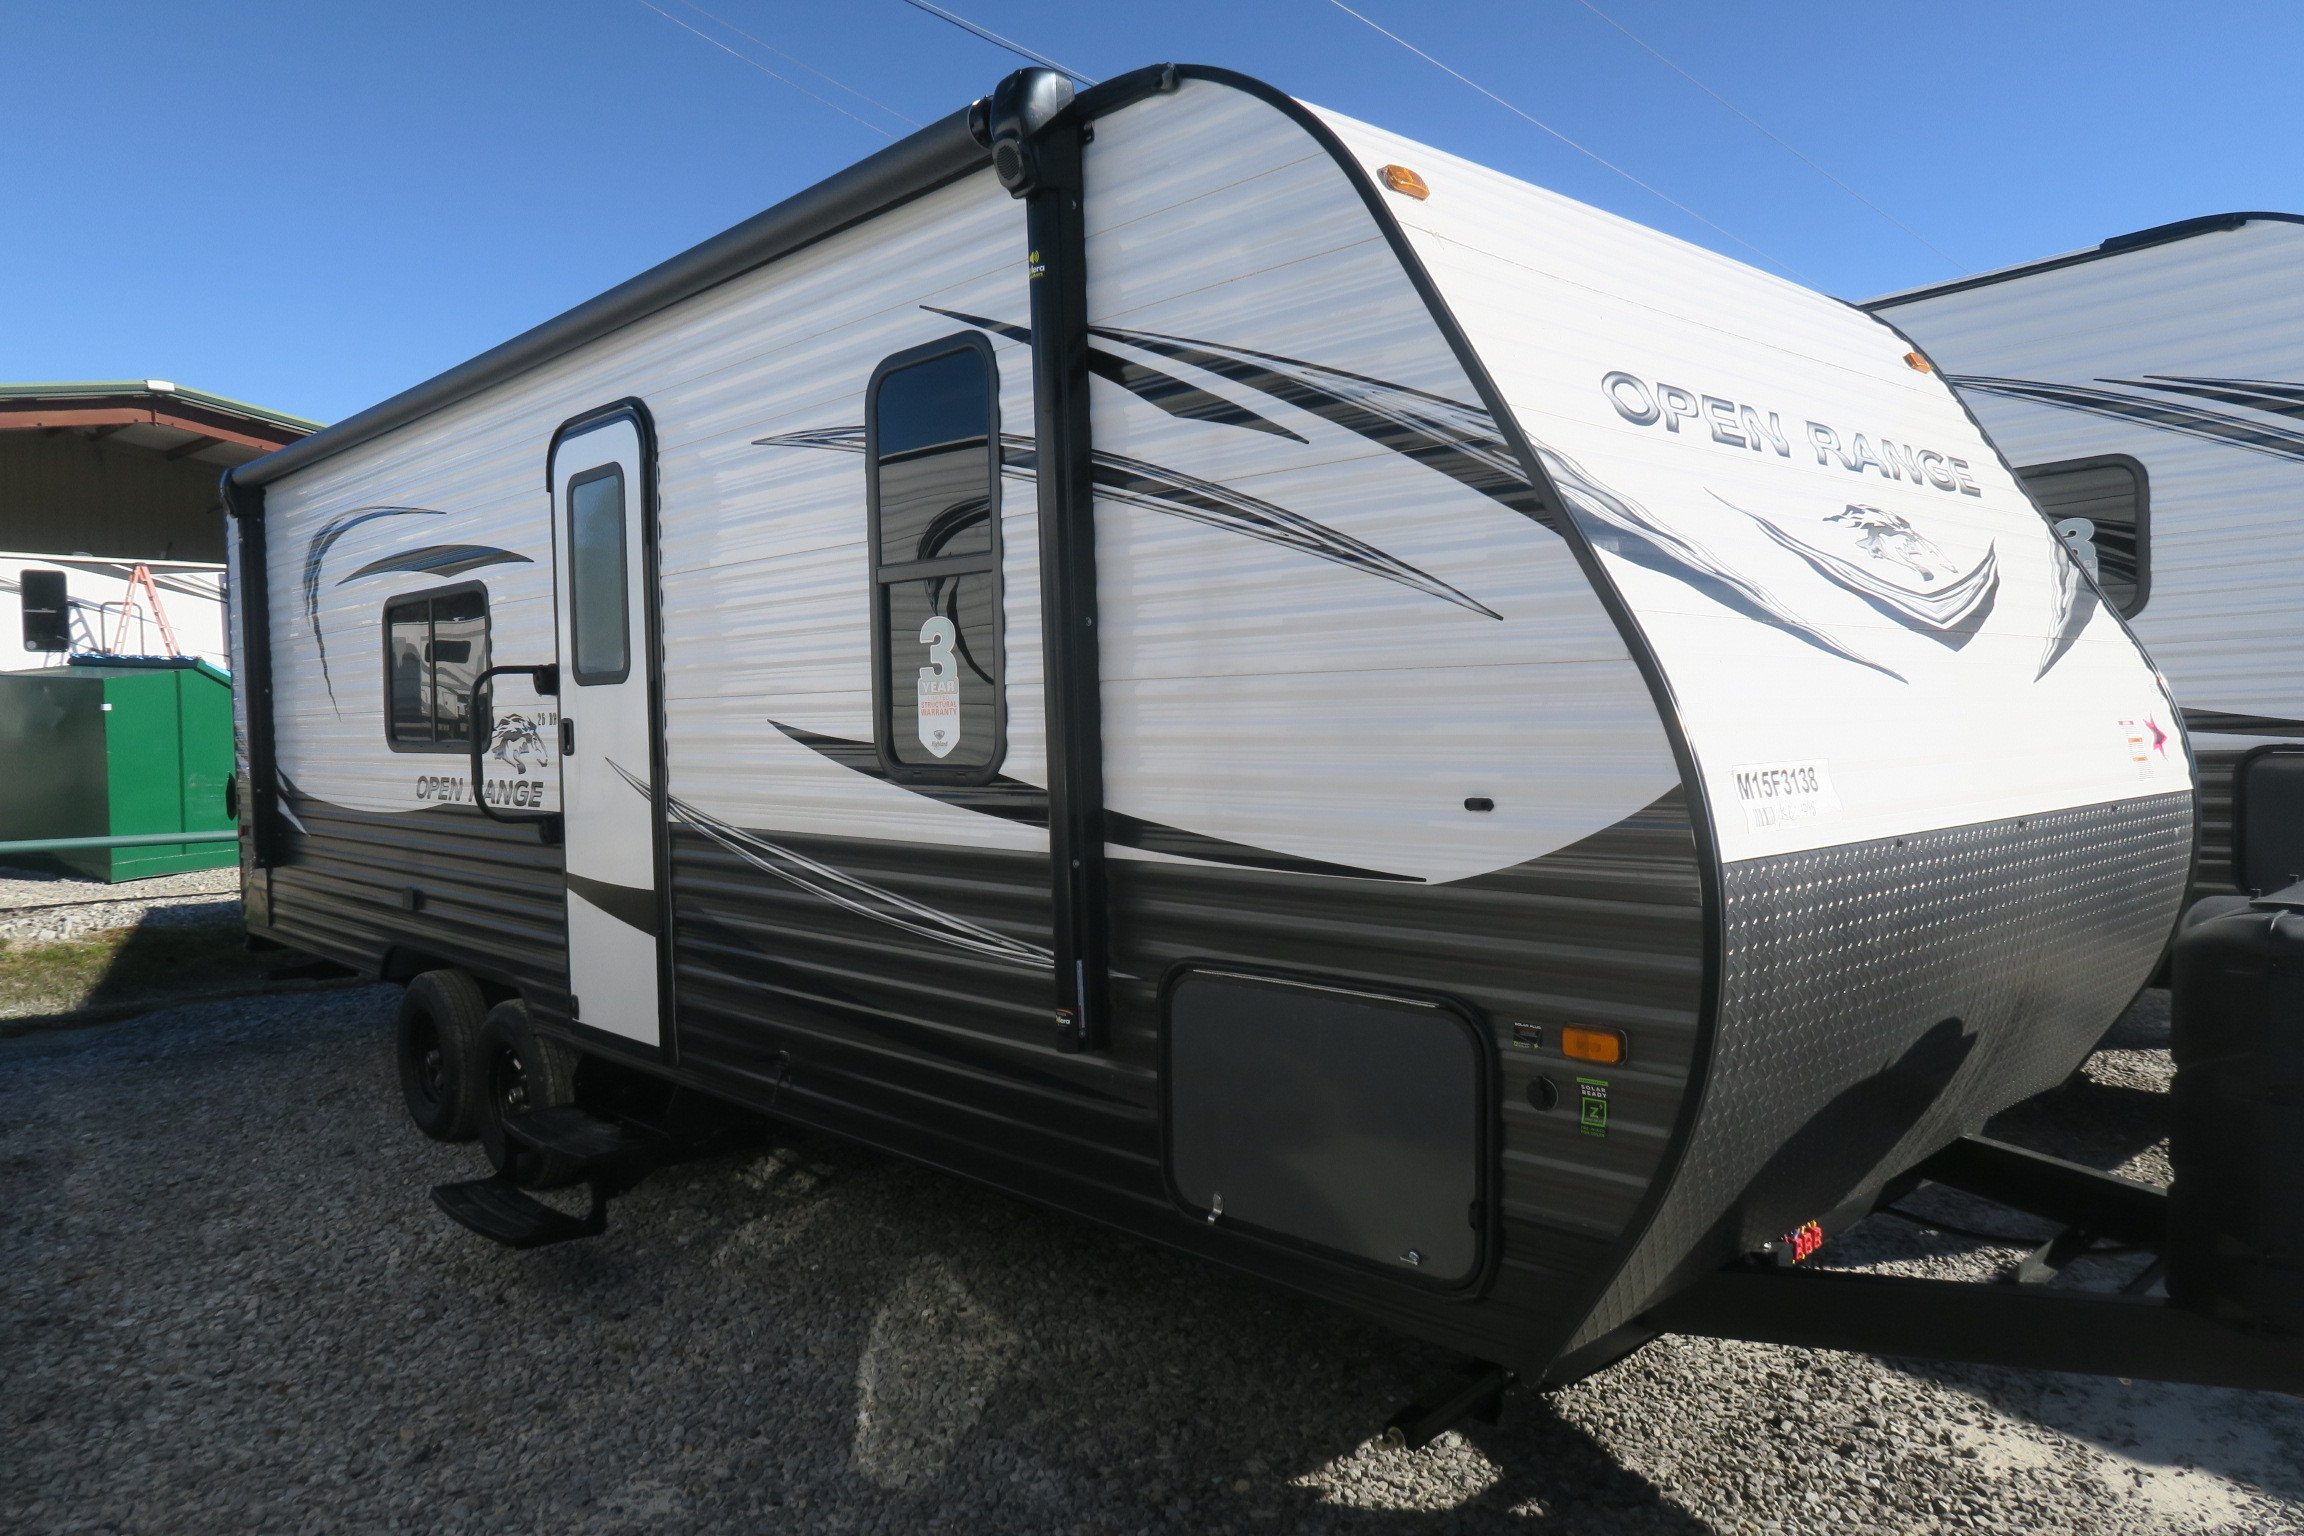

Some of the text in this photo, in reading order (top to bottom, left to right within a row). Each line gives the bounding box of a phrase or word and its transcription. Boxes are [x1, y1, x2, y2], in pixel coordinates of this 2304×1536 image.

[1601, 370, 1982, 498] OPEN RANGE
[919, 616, 957, 678] 3
[922, 681, 955, 692] YEAR
[921, 708, 957, 716] WARRANTY
[416, 775, 463, 800] OPEN
[1737, 767, 1818, 800] M15F3138
[1581, 1084, 1606, 1092] SOLAR
[1581, 1090, 1607, 1098] READY
